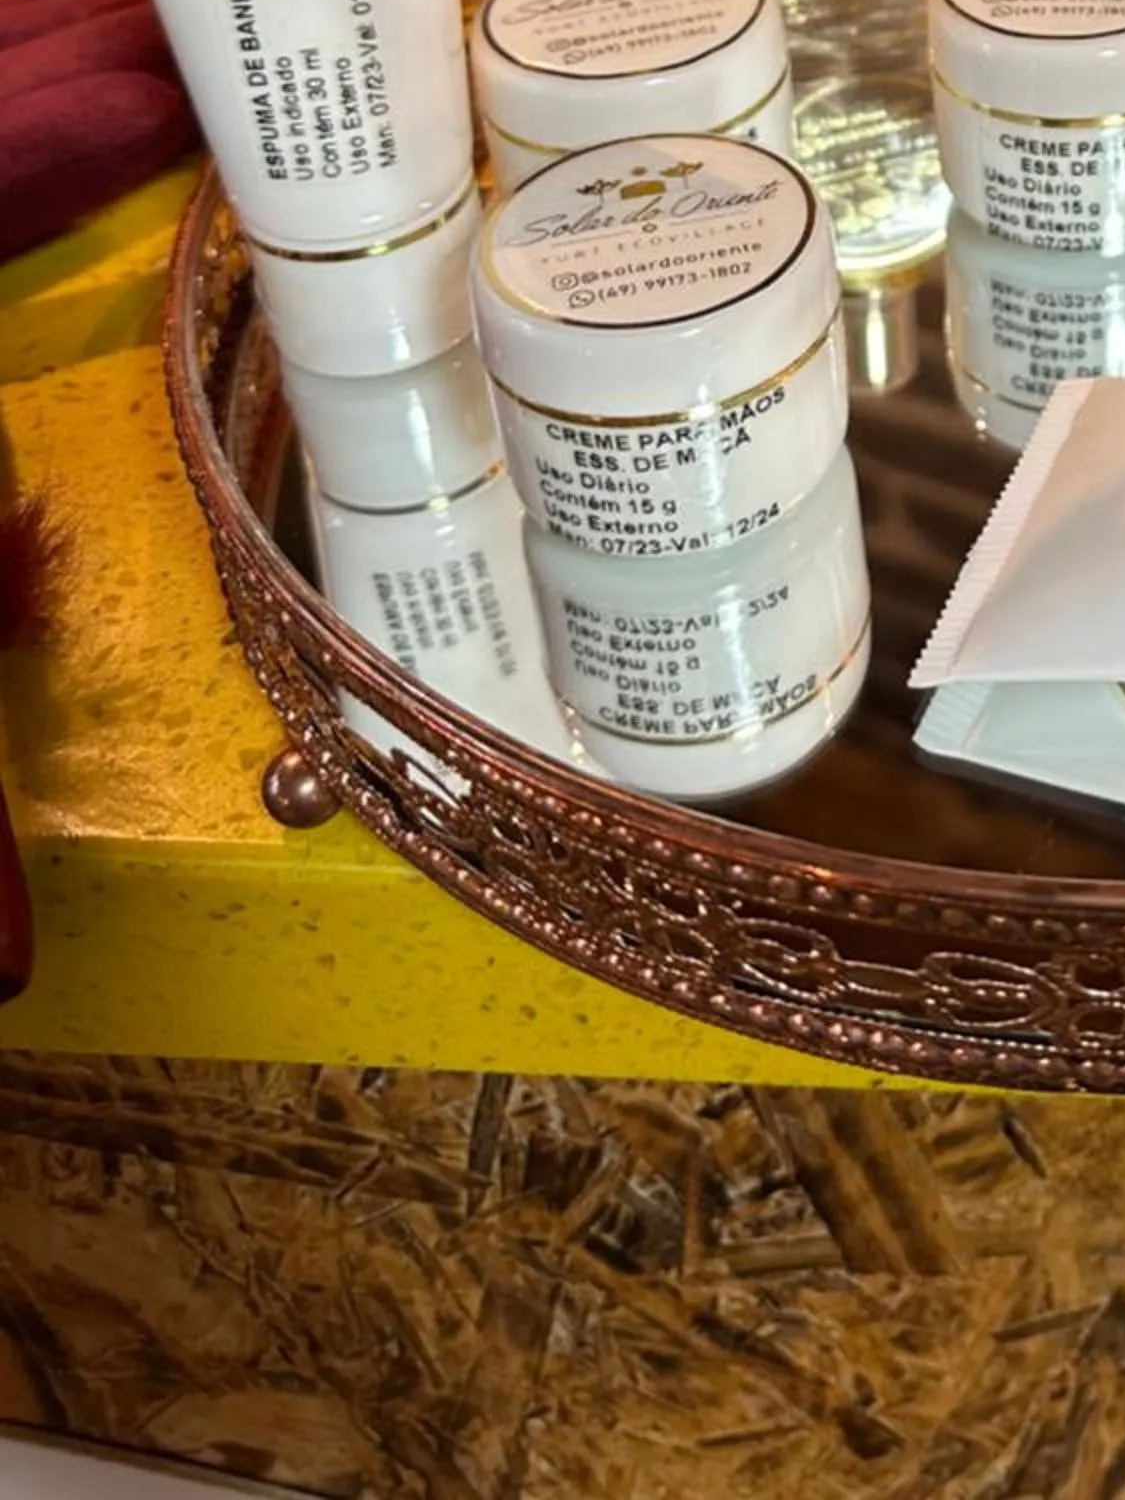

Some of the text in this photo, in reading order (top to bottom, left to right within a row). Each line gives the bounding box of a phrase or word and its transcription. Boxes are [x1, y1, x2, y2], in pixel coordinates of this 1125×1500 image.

[243, 56, 268, 87] DE
[304, 77, 328, 100] 30
[274, 56, 315, 181] Uso indicado
[334, 57, 371, 175] Uso Externo
[252, 92, 288, 180] ESPUMA
[999, 132, 1071, 158] CREME
[984, 166, 1082, 197] Uso Diário
[1020, 157, 1064, 178] ESS.
[1071, 159, 1098, 177] DE
[506, 204, 616, 246] Solar
[621, 196, 665, 226] do
[987, 205, 1101, 234] Uso Externo
[1062, 200, 1083, 215] 15
[598, 262, 753, 304] (49) 99173-1802
[546, 423, 632, 451] CREME
[536, 456, 651, 495] Uso Diário
[573, 451, 626, 473] ESS.
[634, 454, 670, 474] DE
[539, 479, 677, 516] Contém 15 g
[545, 503, 679, 535] Uso Externo
[726, 501, 781, 539] 12/24
